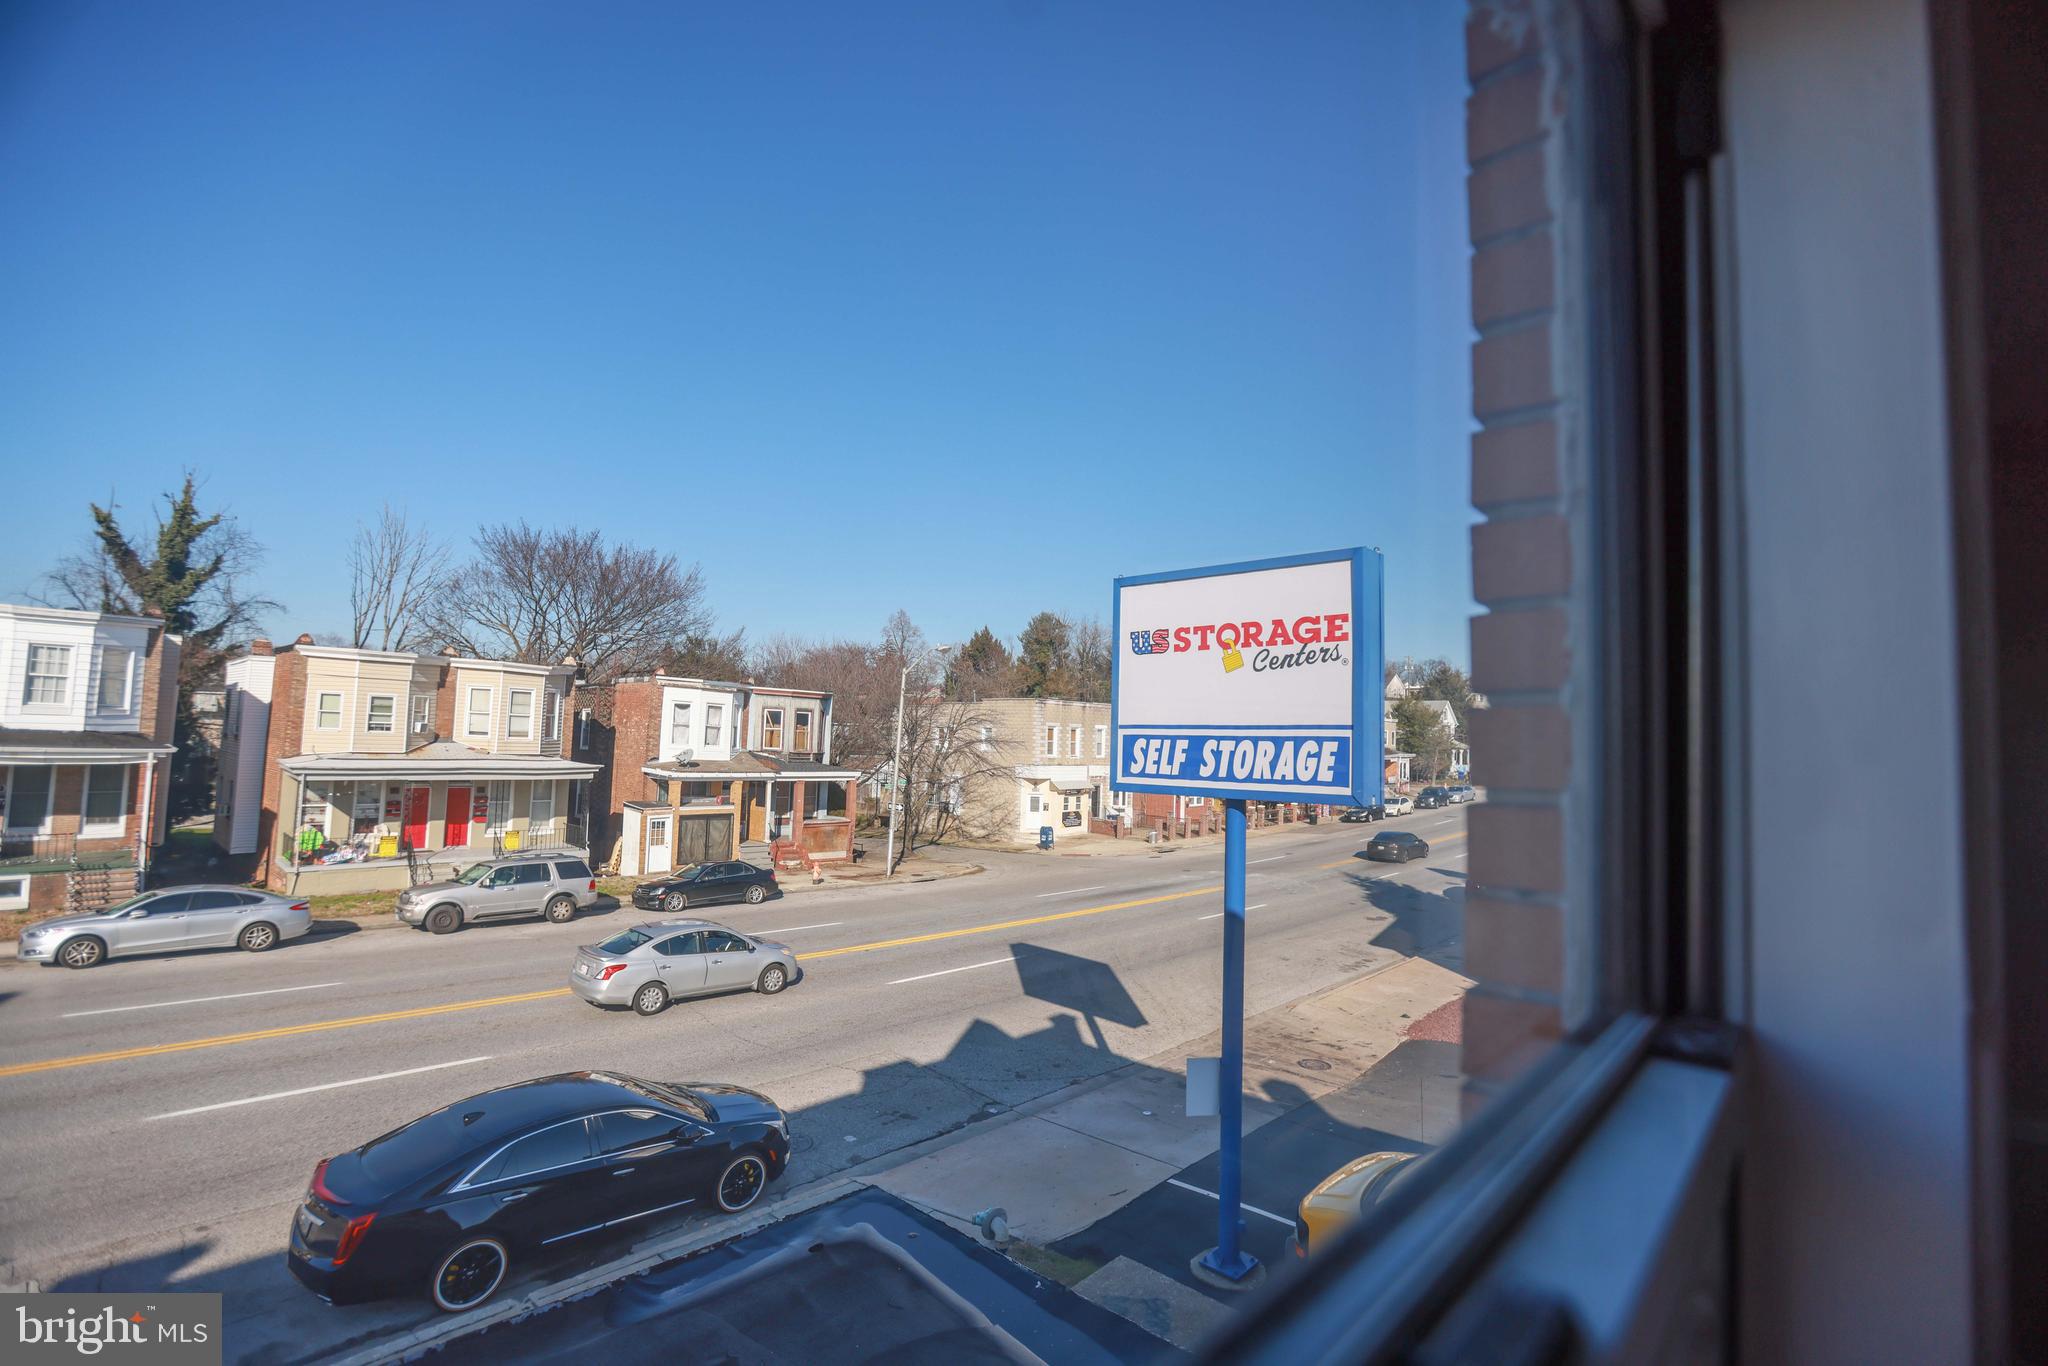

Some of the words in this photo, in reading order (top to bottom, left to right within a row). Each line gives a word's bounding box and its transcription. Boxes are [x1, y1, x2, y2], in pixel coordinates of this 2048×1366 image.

[1130, 628, 1170, 655] US
[1173, 613, 1349, 653] STORAGE
[1129, 737, 1189, 776] SELF
[1199, 739, 1339, 782] STORAGE
